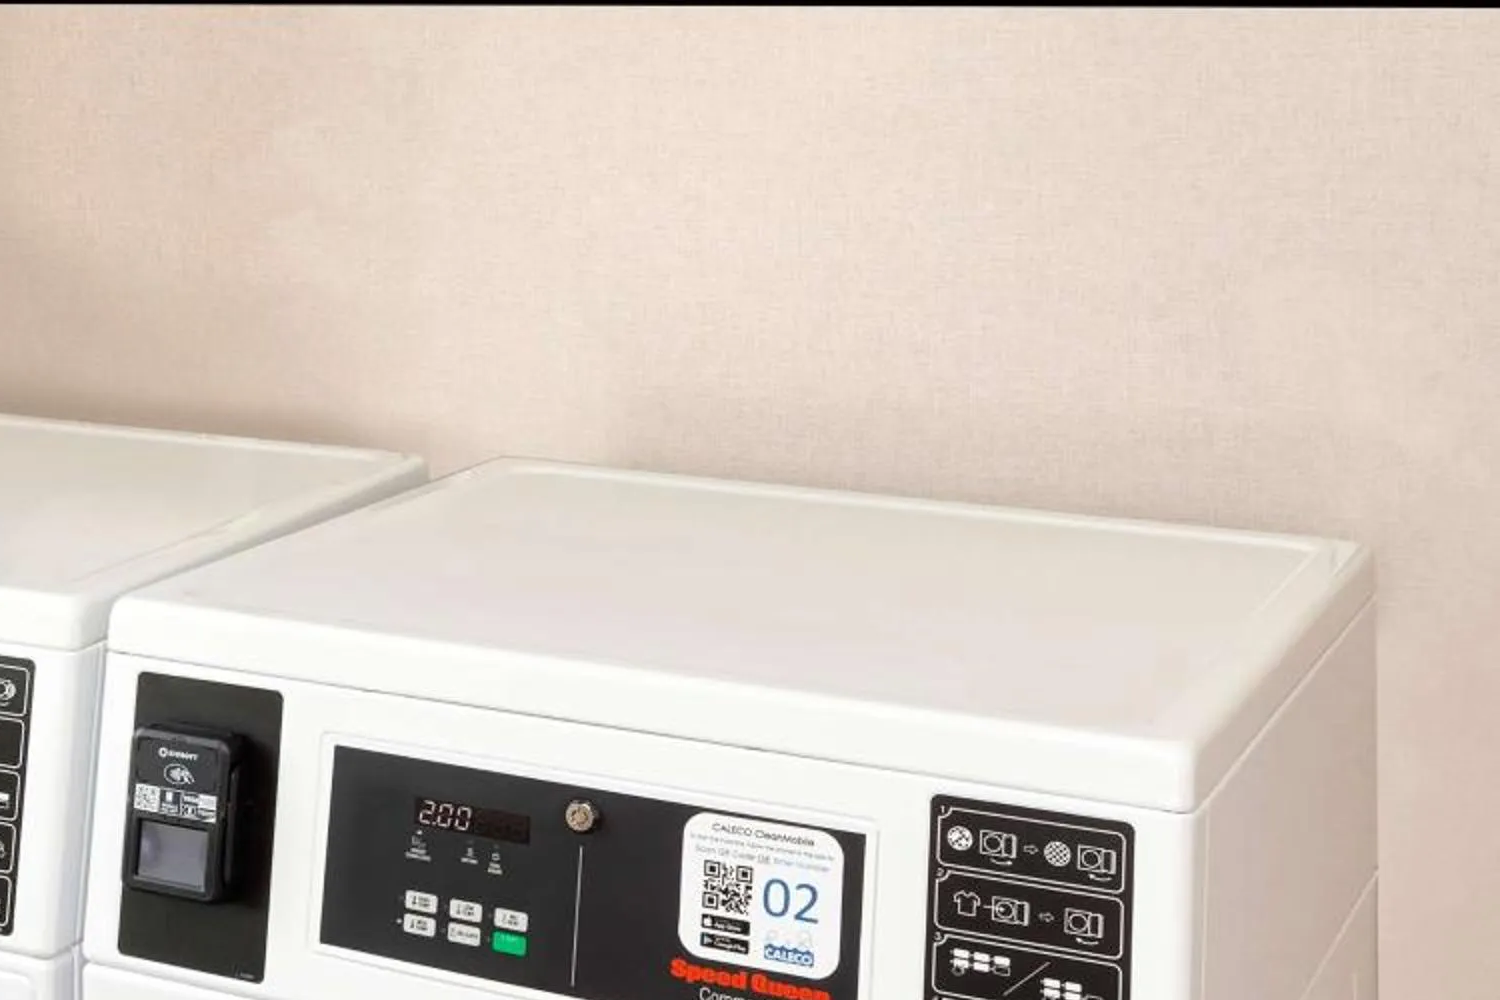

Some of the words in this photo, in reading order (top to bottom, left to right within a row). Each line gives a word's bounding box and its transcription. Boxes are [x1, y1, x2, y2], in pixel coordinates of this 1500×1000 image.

[711, 822, 751, 836] CALECO
[763, 877, 818, 924] 02
[764, 944, 813, 965] CALECO
[670, 957, 746, 990] Speed
